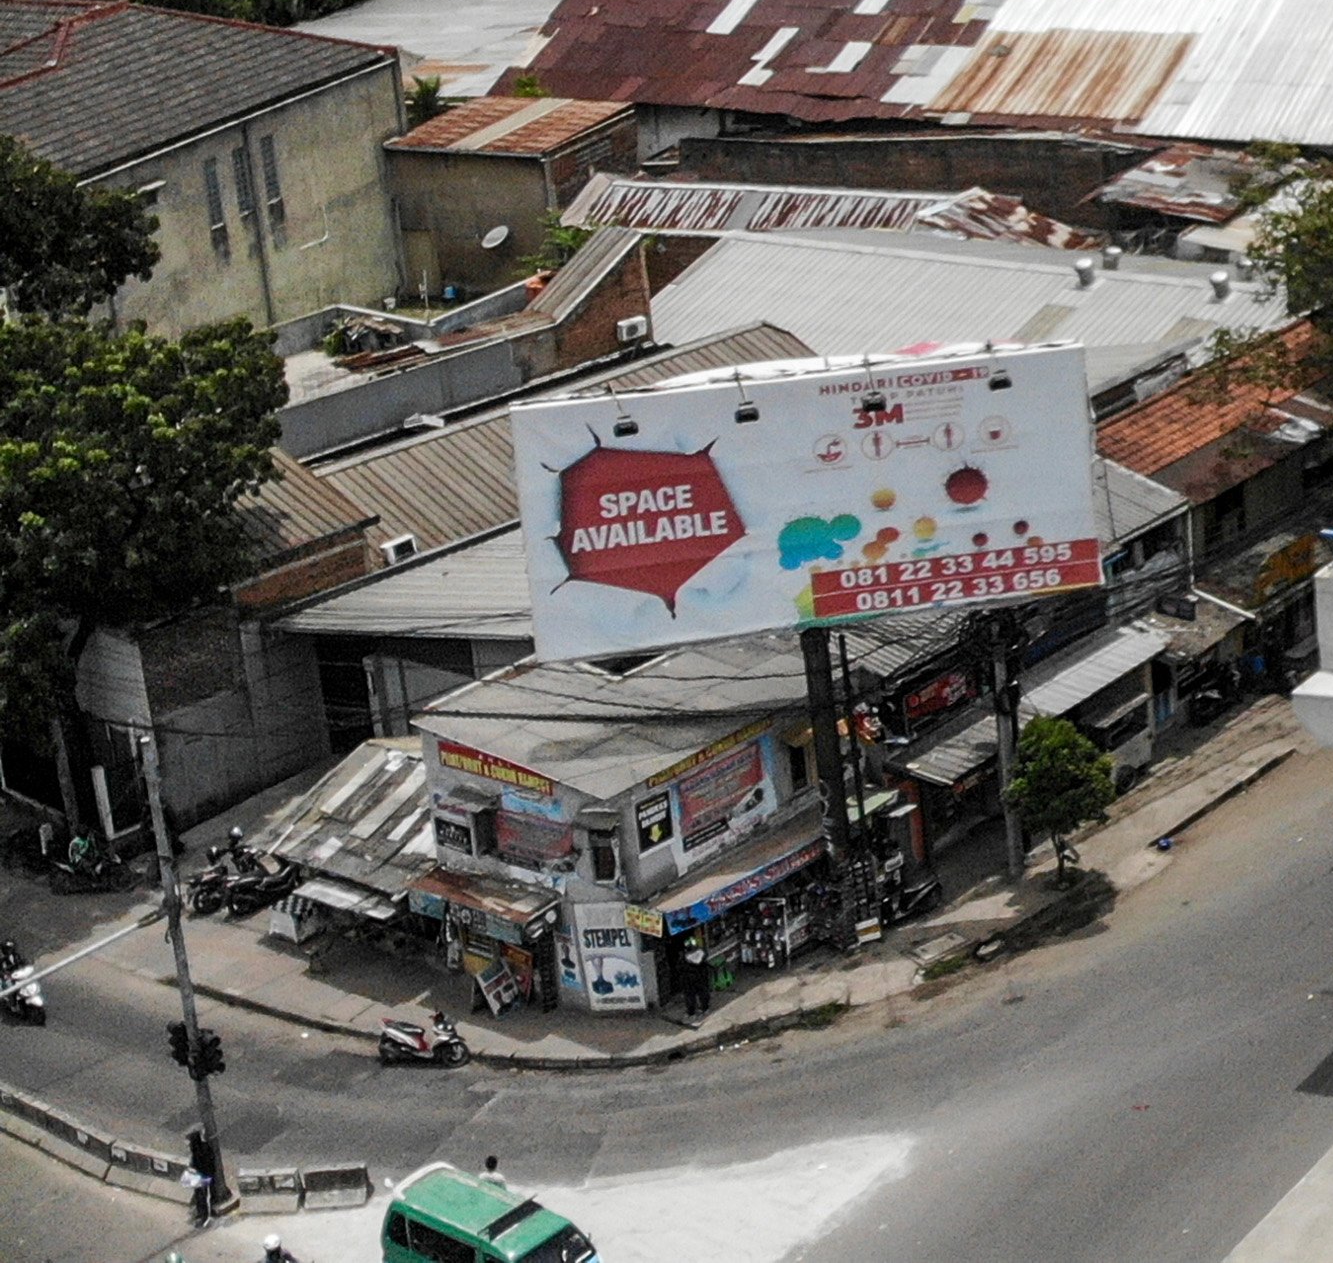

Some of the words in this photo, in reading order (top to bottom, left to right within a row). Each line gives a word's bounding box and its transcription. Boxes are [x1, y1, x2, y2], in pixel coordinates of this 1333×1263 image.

[819, 378, 893, 396] HINDARI
[900, 371, 953, 386] COVID
[853, 403, 904, 429] 3M
[599, 484, 693, 519] SPACE
[571, 510, 728, 554] AVAILABLE
[840, 566, 888, 588] 081
[899, 561, 932, 581] 22
[941, 555, 974, 575] 33
[982, 550, 1014, 569] 44
[1023, 543, 1072, 564] 595
[856, 586, 920, 610] 0811
[931, 581, 963, 601] 22
[972, 576, 1004, 595] 33
[1012, 568, 1061, 590] 656
[583, 928, 631, 949] STEMPEL
